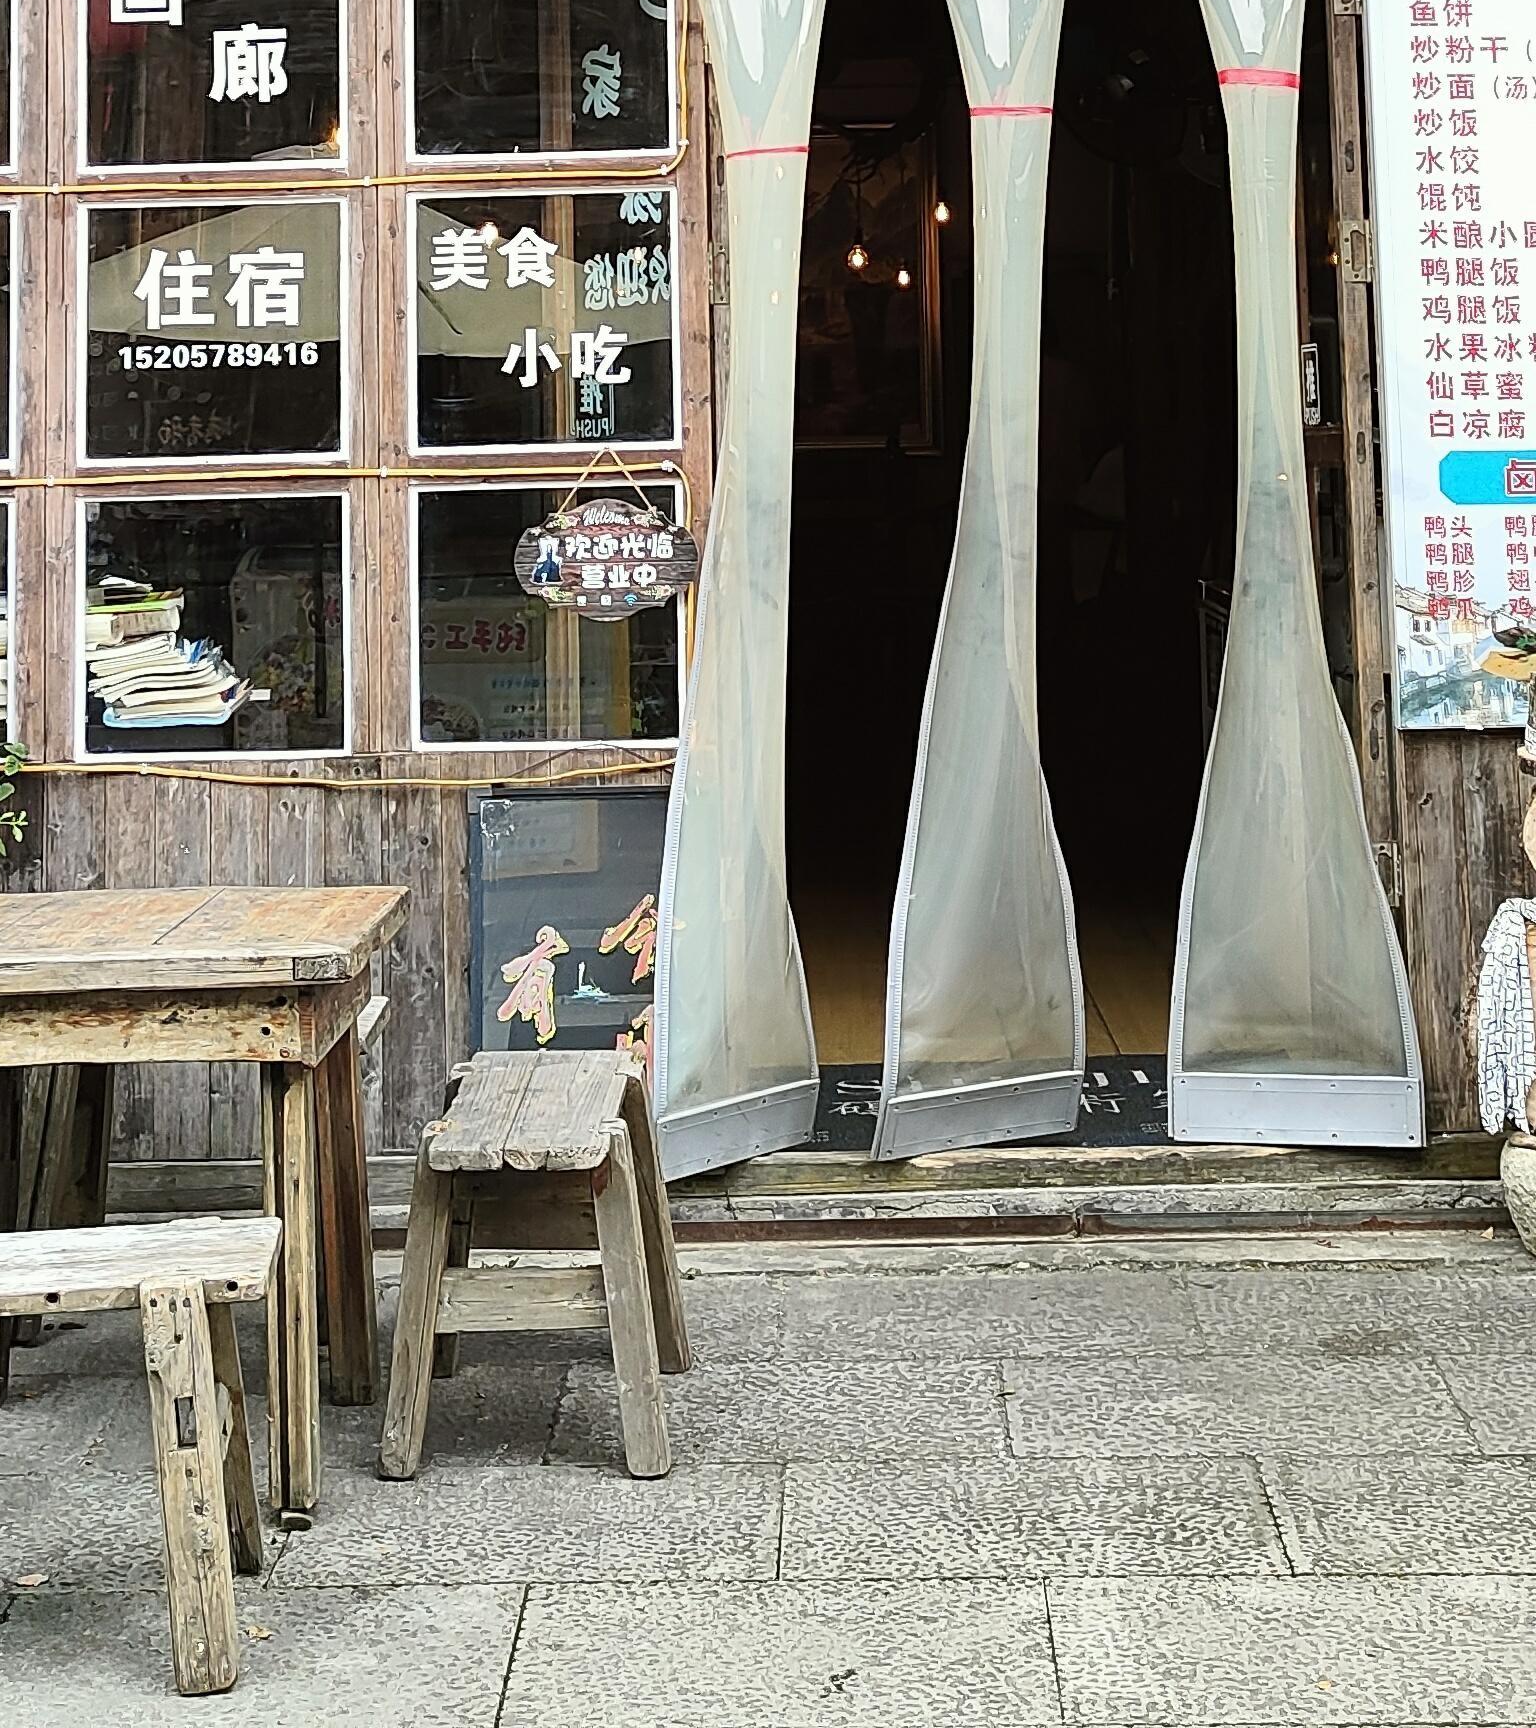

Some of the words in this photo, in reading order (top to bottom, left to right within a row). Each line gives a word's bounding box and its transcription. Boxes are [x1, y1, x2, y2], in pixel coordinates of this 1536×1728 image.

[1409, 0, 1473, 29] 鱼饼
[1413, 109, 1478, 139] 炒饭
[1415, 145, 1480, 175] 水饺
[1416, 183, 1482, 212] 馄饨
[429, 225, 559, 292] 美食
[1421, 256, 1520, 287] 鸭腿饭
[133, 246, 306, 331] 住宿
[1422, 294, 1522, 325] 鸡腿饭
[118, 341, 319, 370] 15205789416
[500, 323, 633, 388] 小吃
[1425, 370, 1525, 402] 仙草蜜
[1429, 409, 1526, 440] 白凉腐
[1424, 515, 1473, 539] 鸭头
[564, 532, 675, 561] 欢迎光临
[1425, 542, 1475, 566] 鸭腿
[581, 563, 658, 589] 营业中
[1426, 569, 1476, 593] 鸭胗
